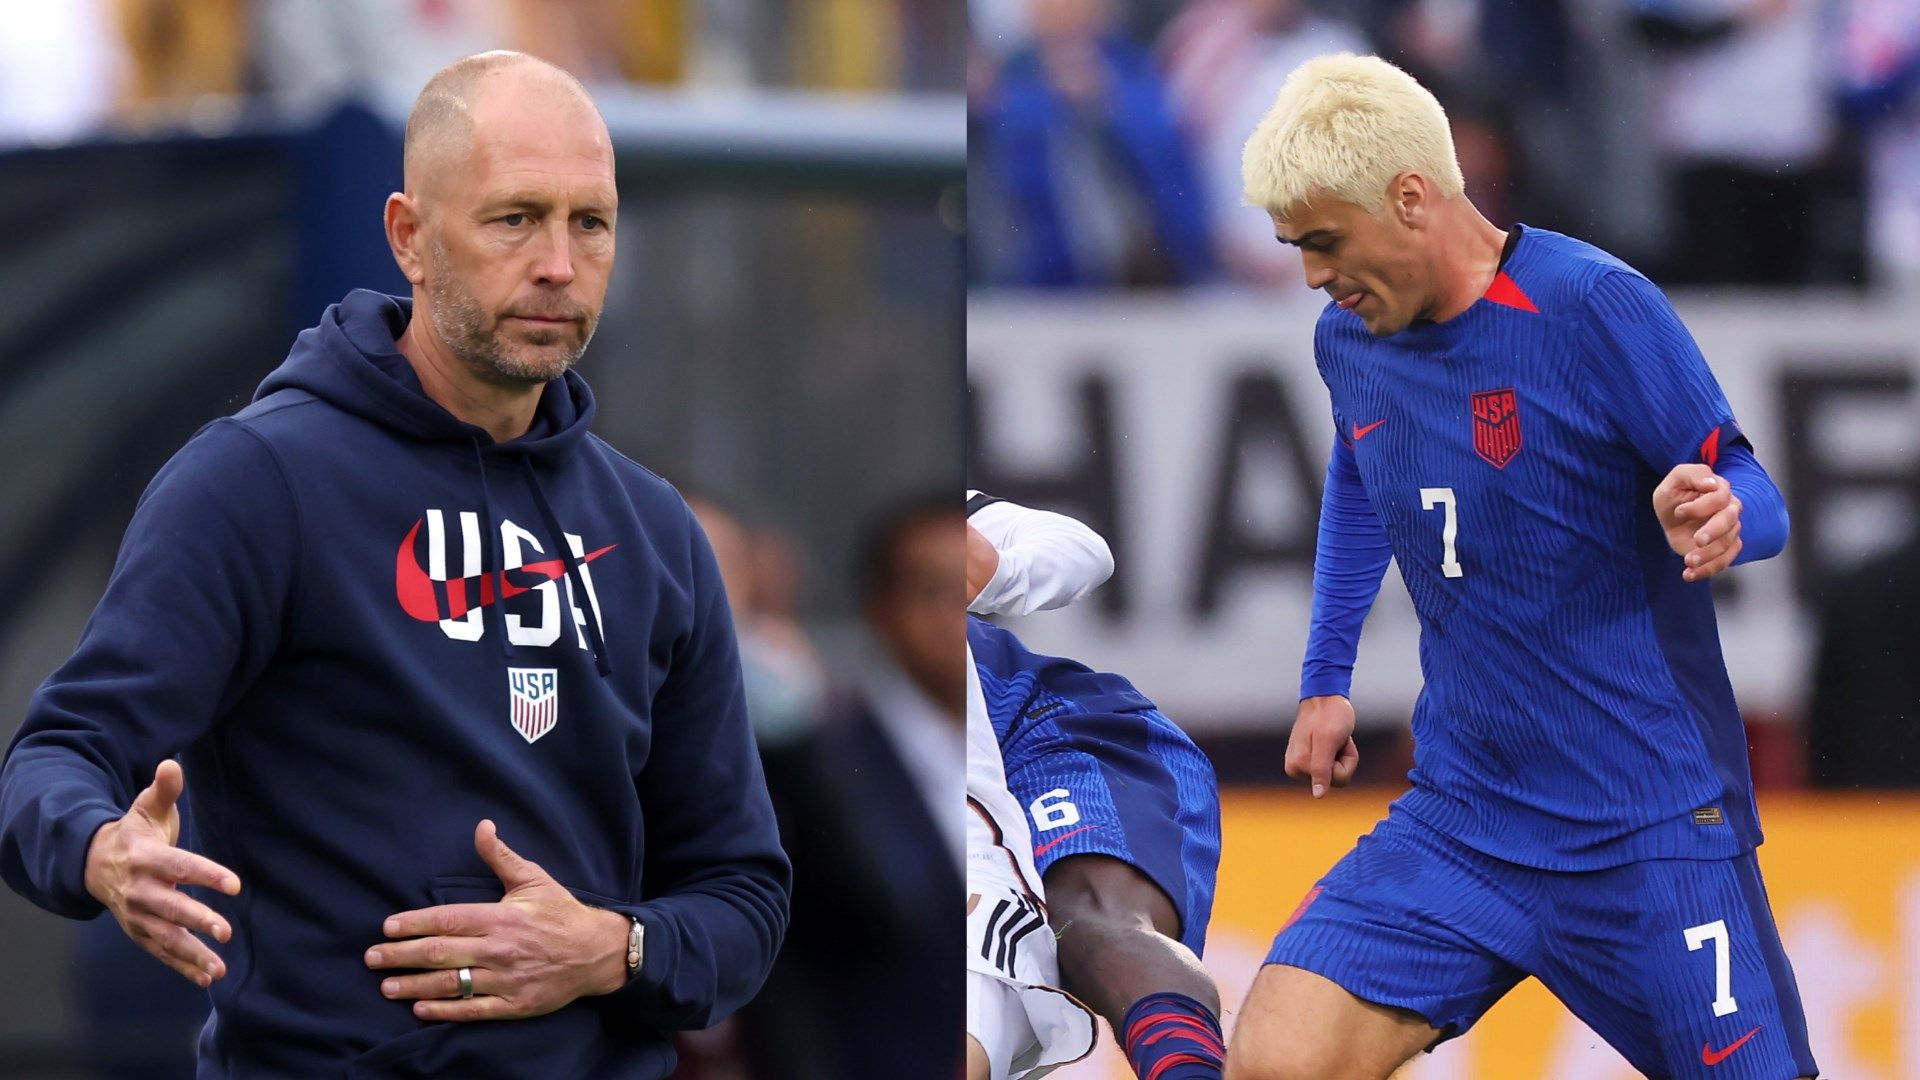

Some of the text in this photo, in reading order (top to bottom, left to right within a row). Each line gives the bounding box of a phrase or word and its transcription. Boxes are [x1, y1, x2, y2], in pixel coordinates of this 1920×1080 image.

[1474, 393, 1515, 423] USA
[1420, 488, 1463, 578] 7
[426, 509, 606, 656] USA
[512, 672, 554, 700] USA
[1029, 788, 1081, 832] 6
[1683, 919, 1738, 1017] 7
